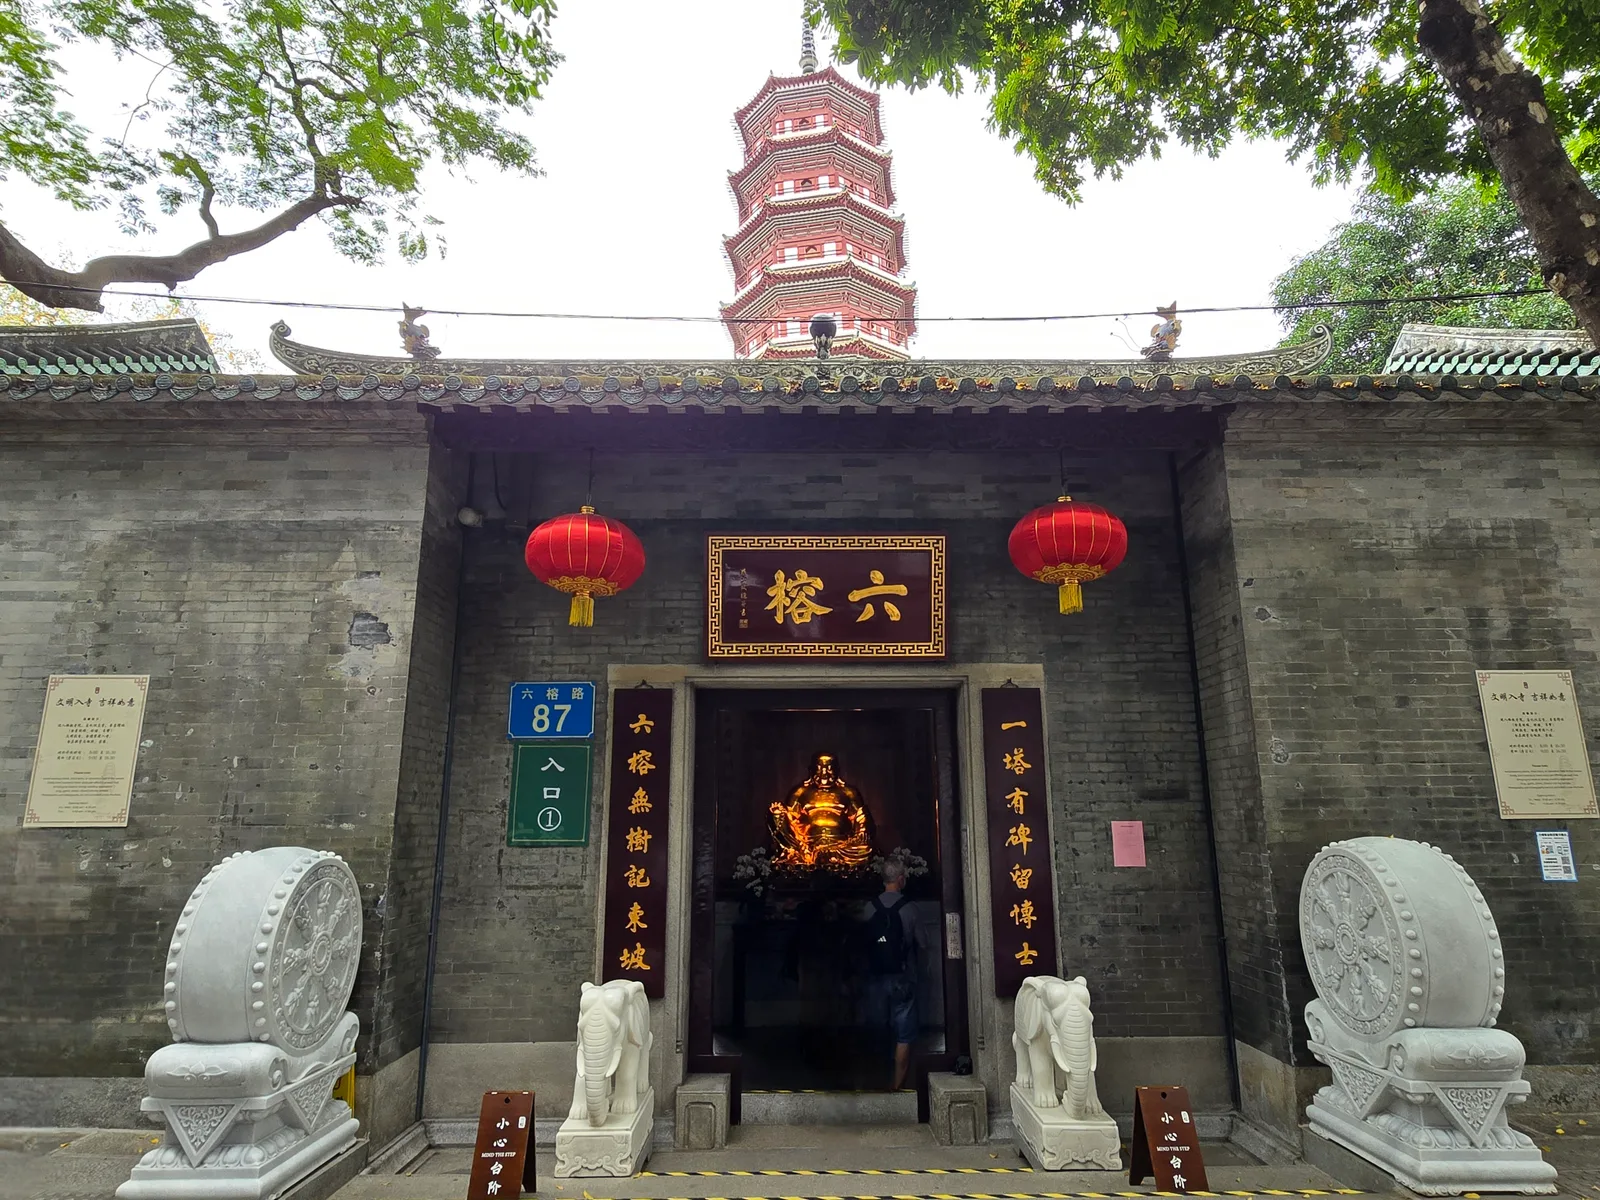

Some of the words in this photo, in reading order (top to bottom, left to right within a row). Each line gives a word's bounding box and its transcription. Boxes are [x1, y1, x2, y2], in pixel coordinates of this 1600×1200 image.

[521, 687, 585, 701] 六榕路
[1530, 692, 1567, 702] 吉祥如意
[55, 697, 93, 708] 文明入寺
[98, 697, 136, 708] 吉祥如意
[531, 703, 573, 733] 87
